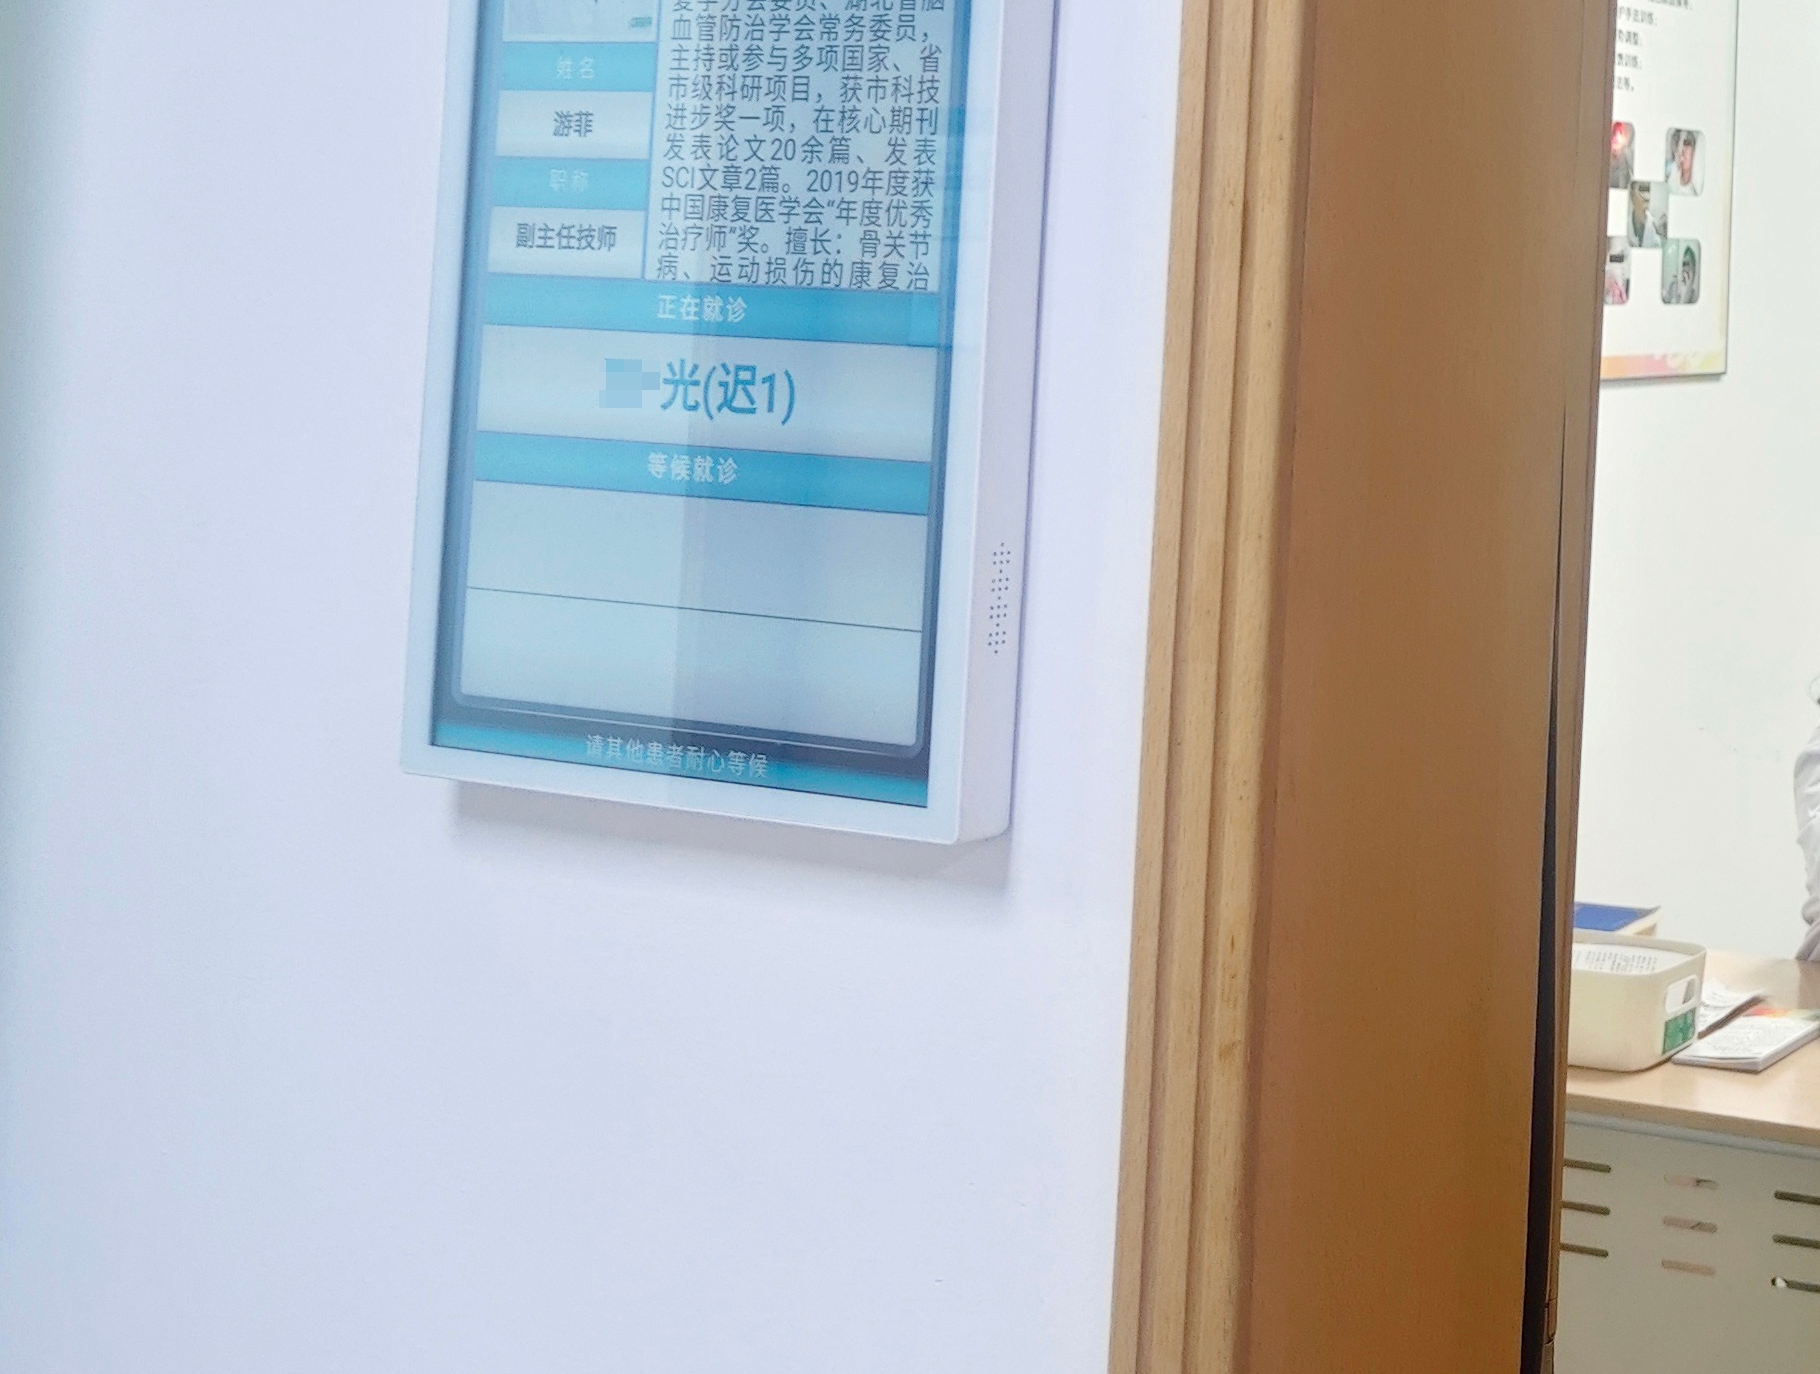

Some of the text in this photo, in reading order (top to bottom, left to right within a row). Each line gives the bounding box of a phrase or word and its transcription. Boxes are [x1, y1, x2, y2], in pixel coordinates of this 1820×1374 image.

[670, 13, 931, 44] 血管防治学会常务委员，
[668, 44, 943, 73] 主持或参与多项国家、省
[667, 75, 942, 105] 市级科研项目，获市科技
[665, 104, 939, 135] 进步奖一项，在核心期刊
[515, 222, 618, 252] 副主任技师
[656, 255, 929, 292] 病、运动损伤的康复治
[656, 294, 748, 323] 正在就诊
[647, 451, 738, 484] 等候就诊
[586, 734, 769, 778] 请其他患者耐心等候
